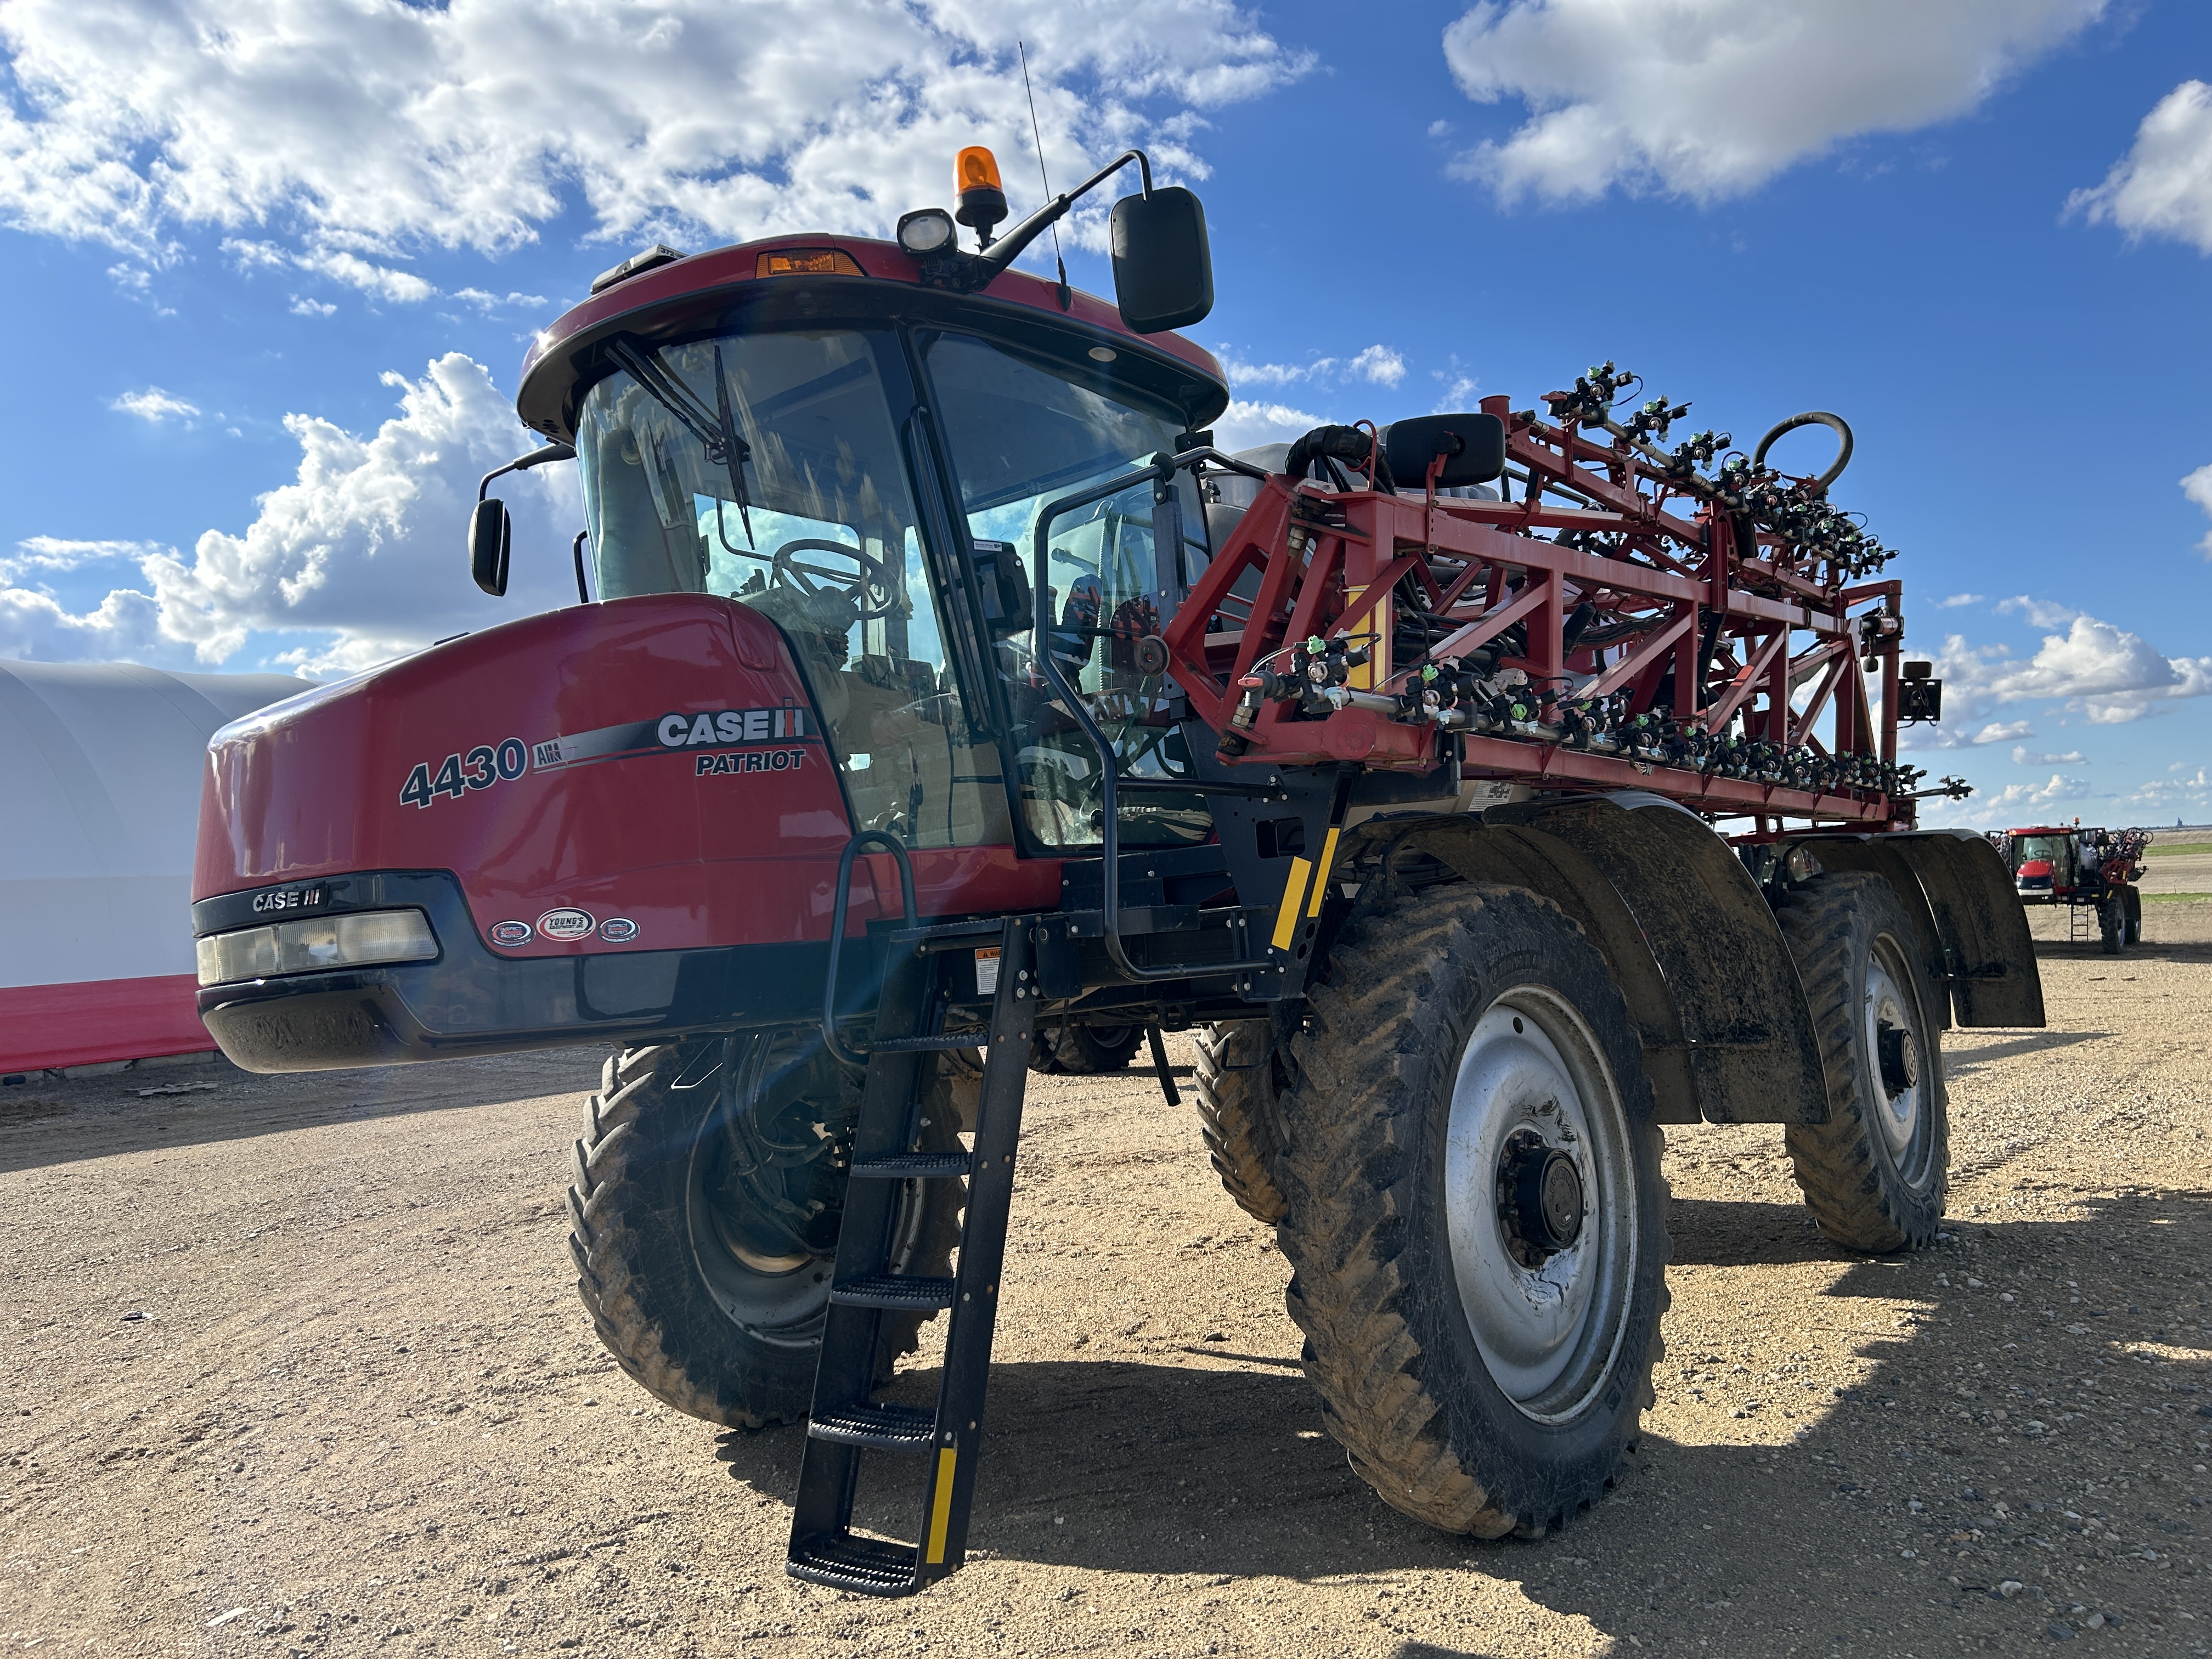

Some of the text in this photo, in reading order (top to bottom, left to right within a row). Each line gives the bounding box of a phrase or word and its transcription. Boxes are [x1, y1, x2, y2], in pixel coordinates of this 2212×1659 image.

[658, 710, 769, 747] CASE
[399, 737, 528, 809] 4430
[695, 749, 806, 776] PATRIOT
[253, 891, 300, 912] CASE
[549, 917, 584, 926] YOUNG'S
